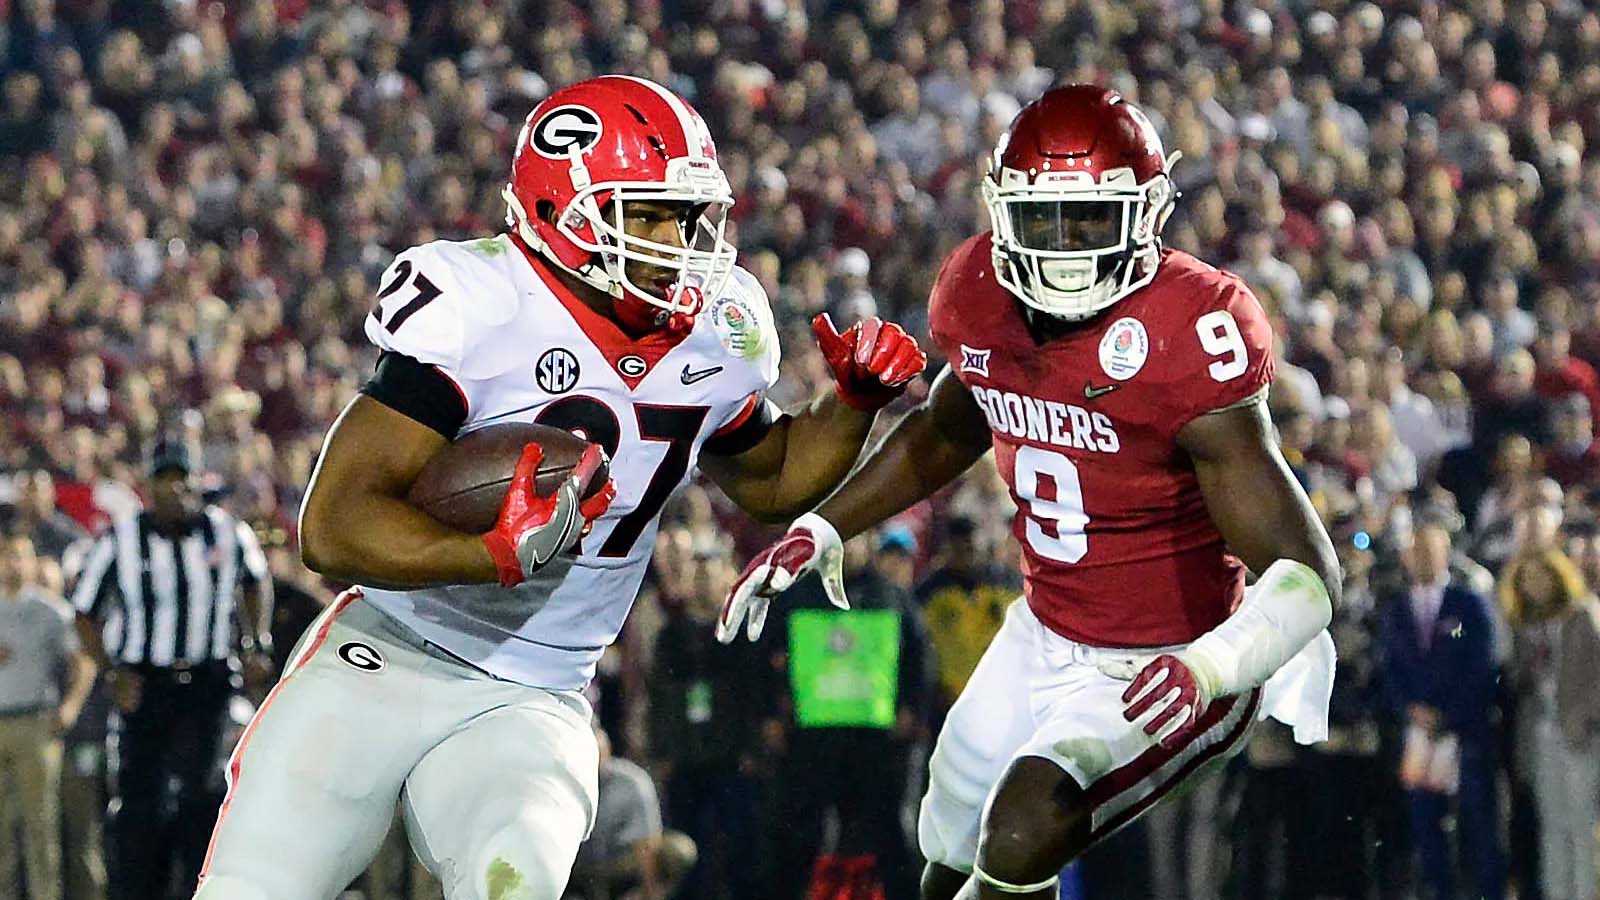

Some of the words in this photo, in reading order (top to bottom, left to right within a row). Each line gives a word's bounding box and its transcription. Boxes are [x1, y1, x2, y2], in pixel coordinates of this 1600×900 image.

[533, 108, 598, 155] G
[619, 357, 645, 375] G
[963, 350, 988, 372] XII
[1195, 310, 1249, 383] 9
[539, 350, 578, 392] SEC
[971, 385, 1120, 453] SOONERS
[1014, 445, 1091, 564] 9
[338, 642, 382, 670] G
